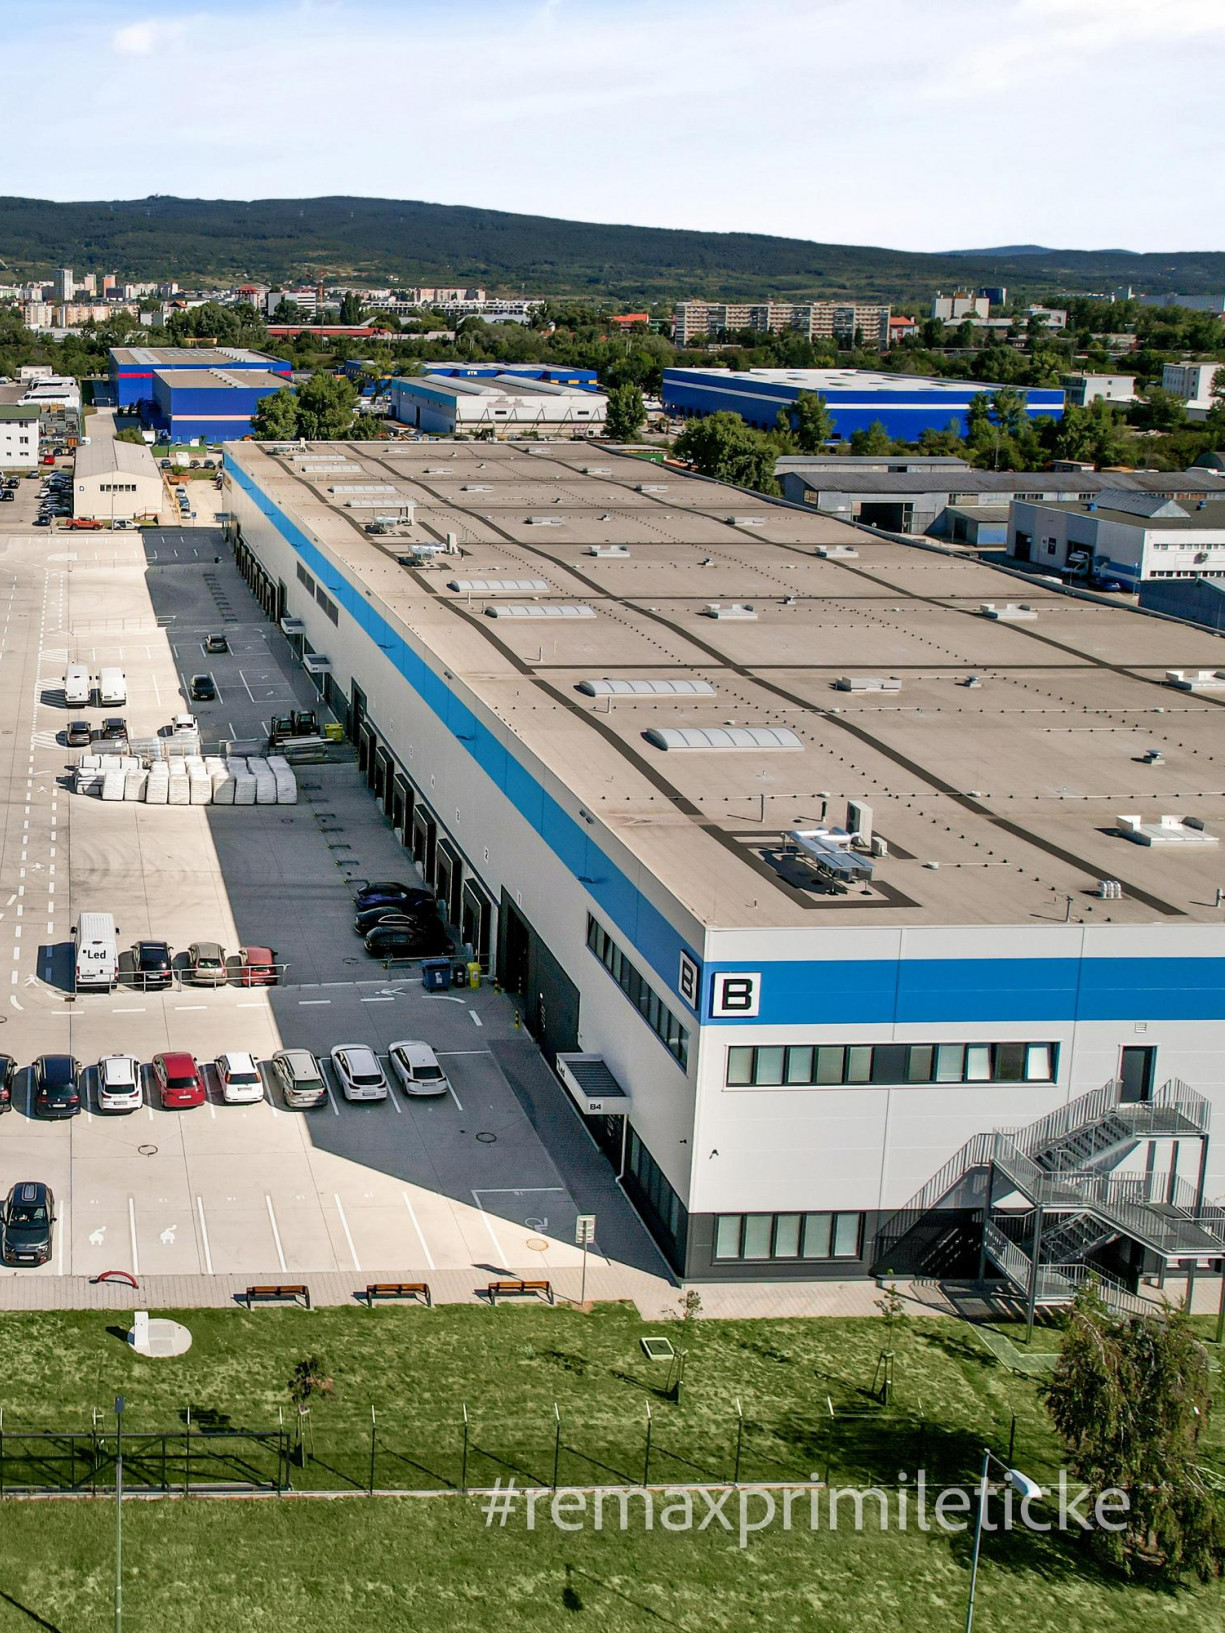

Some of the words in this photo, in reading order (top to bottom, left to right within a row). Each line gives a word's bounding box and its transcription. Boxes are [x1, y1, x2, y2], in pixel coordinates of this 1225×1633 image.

[87, 950, 106, 960] Led
[681, 959, 693, 999] B
[721, 978, 753, 1010] B
[589, 1103, 602, 1111] B4
